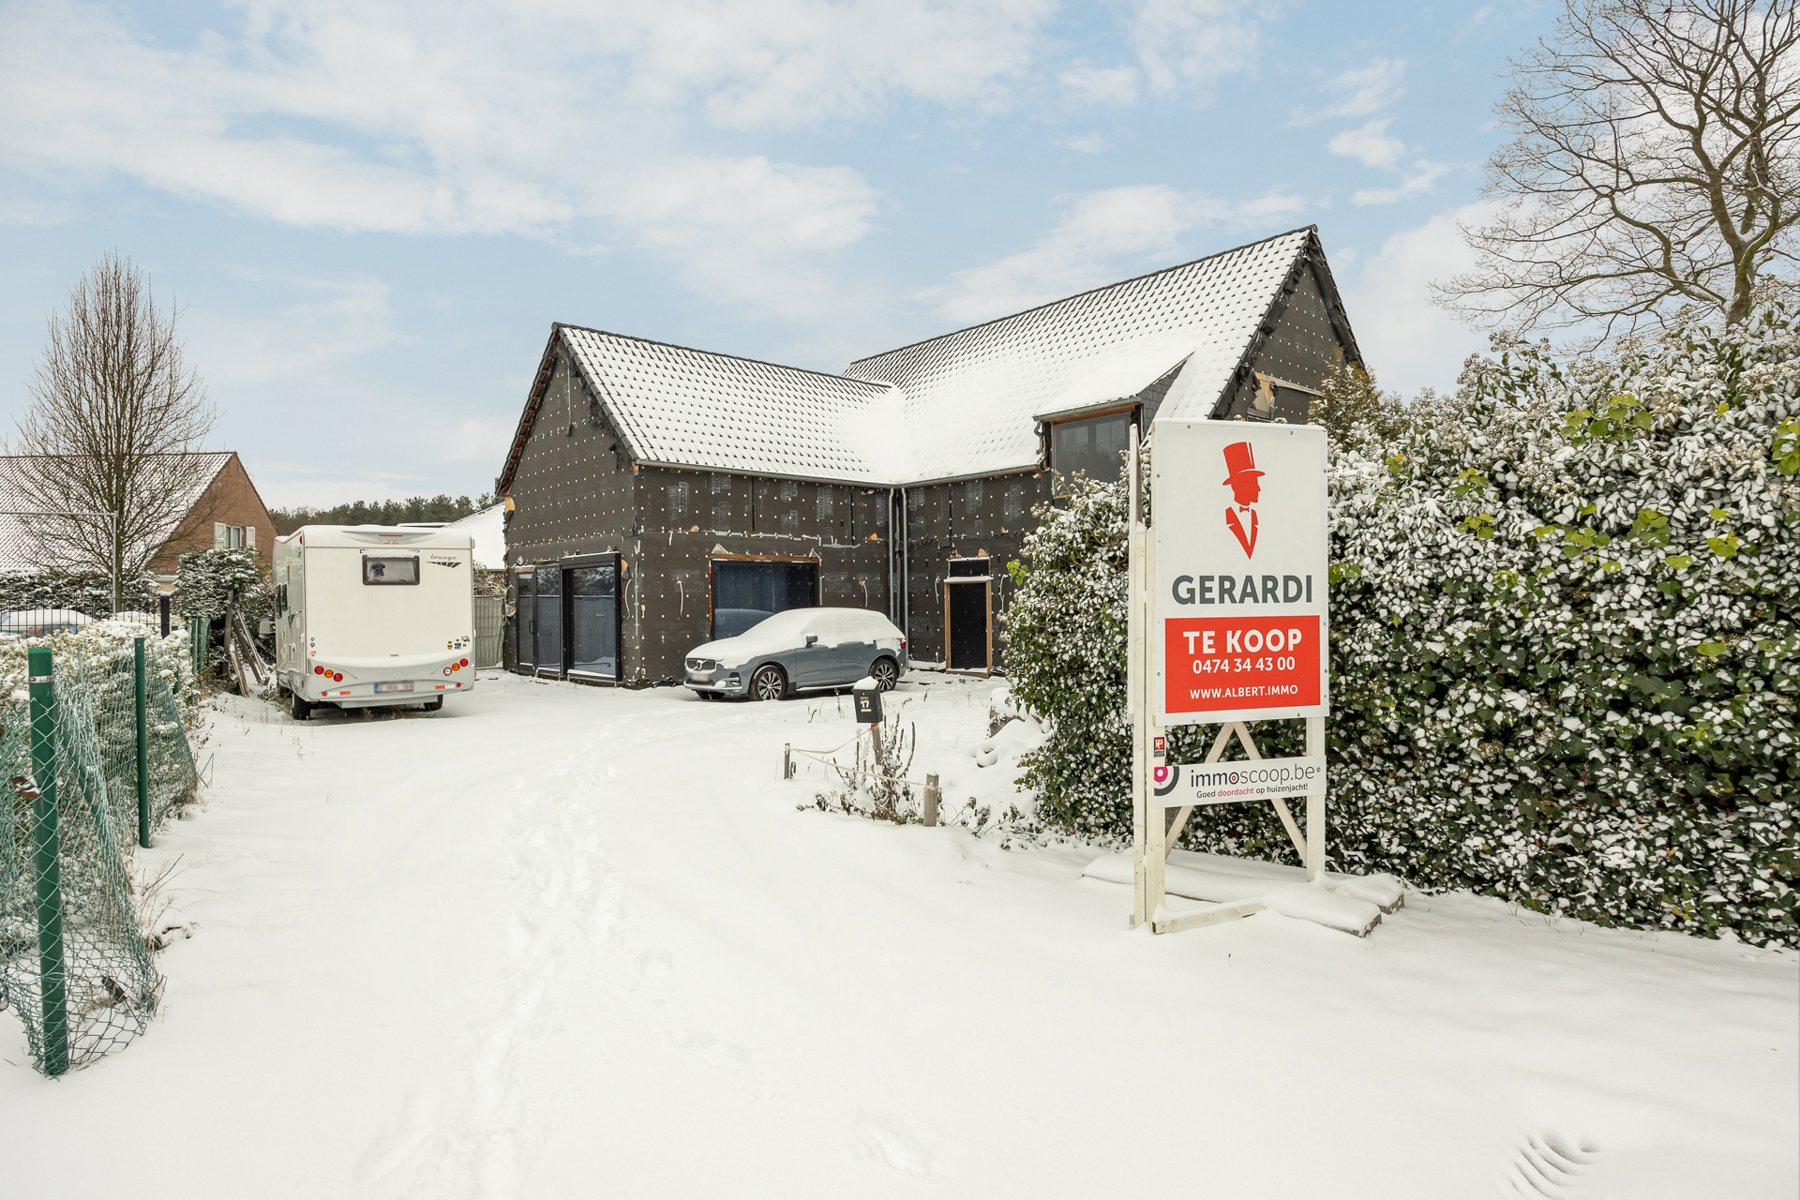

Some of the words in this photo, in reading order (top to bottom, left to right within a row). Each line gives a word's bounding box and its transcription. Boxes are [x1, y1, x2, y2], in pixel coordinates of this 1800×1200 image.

[1172, 575, 1312, 605] GERARDI
[1183, 631, 1216, 654] TE
[1226, 629, 1302, 653] KOOP
[1192, 659, 1230, 674] 0474
[1233, 658, 1252, 672] 34
[1255, 657, 1273, 671] 43
[1277, 656, 1296, 671] 00
[1190, 684, 1298, 699] WWW.ALBERT.IMMO
[860, 700, 870, 709] 17
[1191, 763, 1315, 788] immoscoop.be
[1196, 790, 1216, 799] Goed
[1217, 787, 1254, 797] doordacht
[1266, 783, 1308, 793] huizenjacht!
